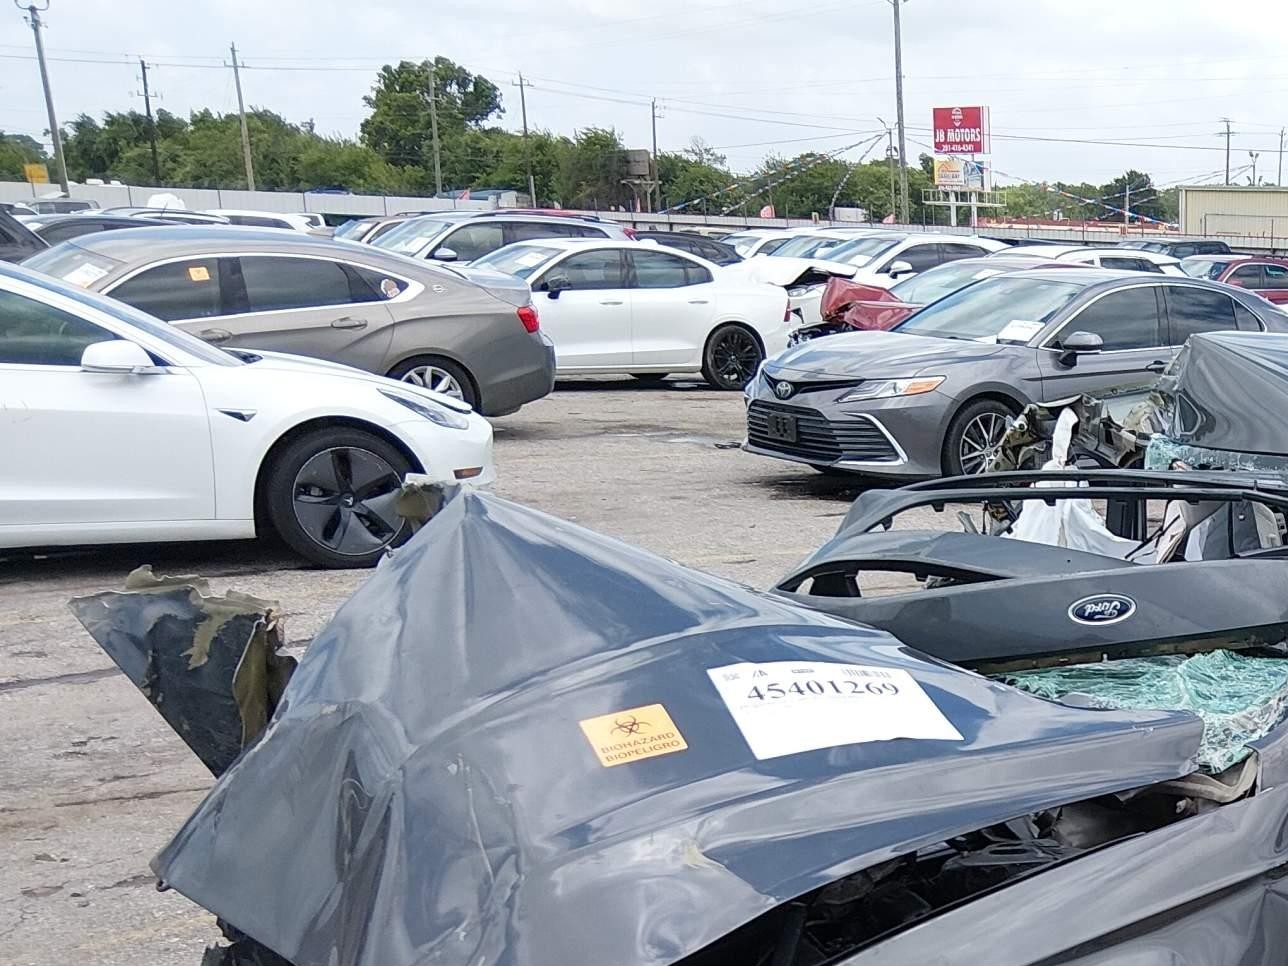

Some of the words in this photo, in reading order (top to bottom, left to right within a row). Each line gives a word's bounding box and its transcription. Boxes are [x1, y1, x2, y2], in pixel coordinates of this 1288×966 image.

[936, 129, 945, 142] JB
[947, 128, 980, 142] MOTORS
[747, 679, 899, 700] 45401269
[601, 732, 675, 754] BIOHAZARD
[605, 740, 681, 762] BIOPELIGRO
